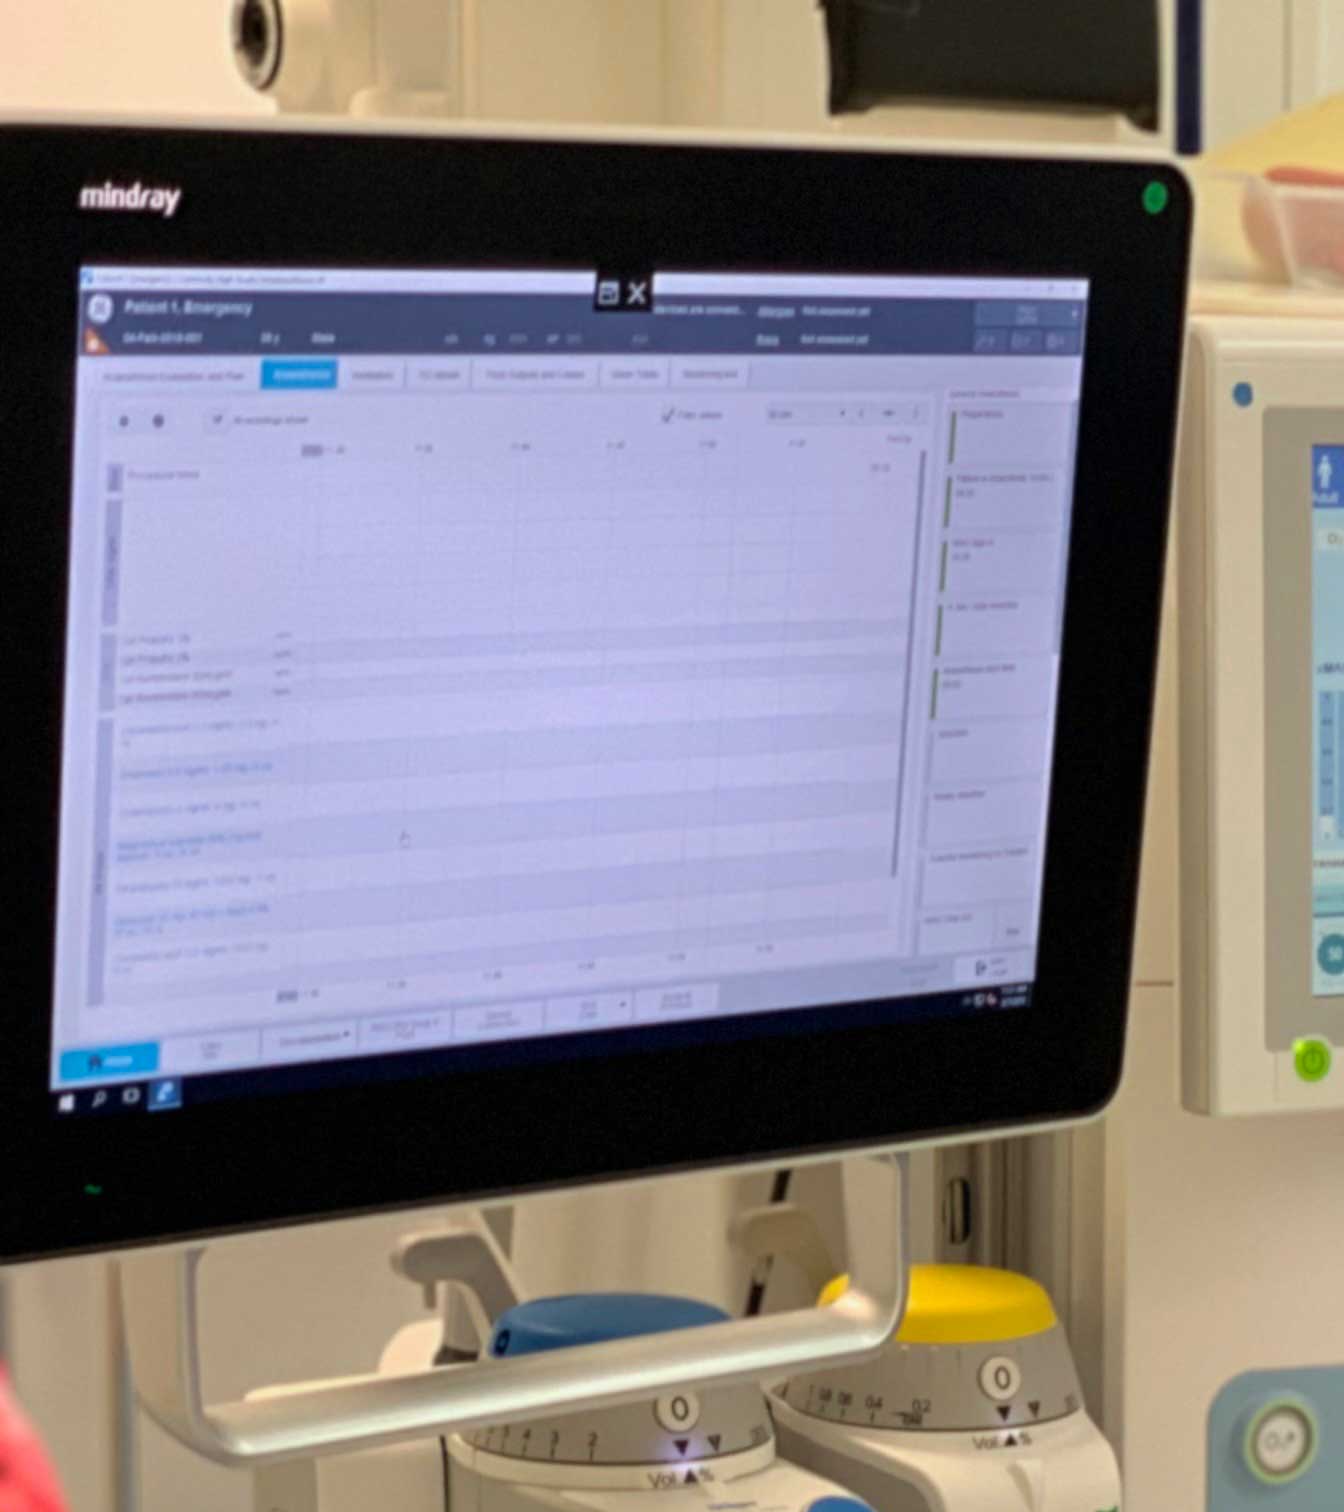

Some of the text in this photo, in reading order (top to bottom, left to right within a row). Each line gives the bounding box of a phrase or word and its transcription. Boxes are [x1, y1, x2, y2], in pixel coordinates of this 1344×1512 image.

[80, 181, 182, 217] mindray
[125, 300, 169, 315] Patient
[184, 300, 252, 318] Emergency
[994, 1364, 1012, 1390] 0
[671, 1395, 690, 1422] 0
